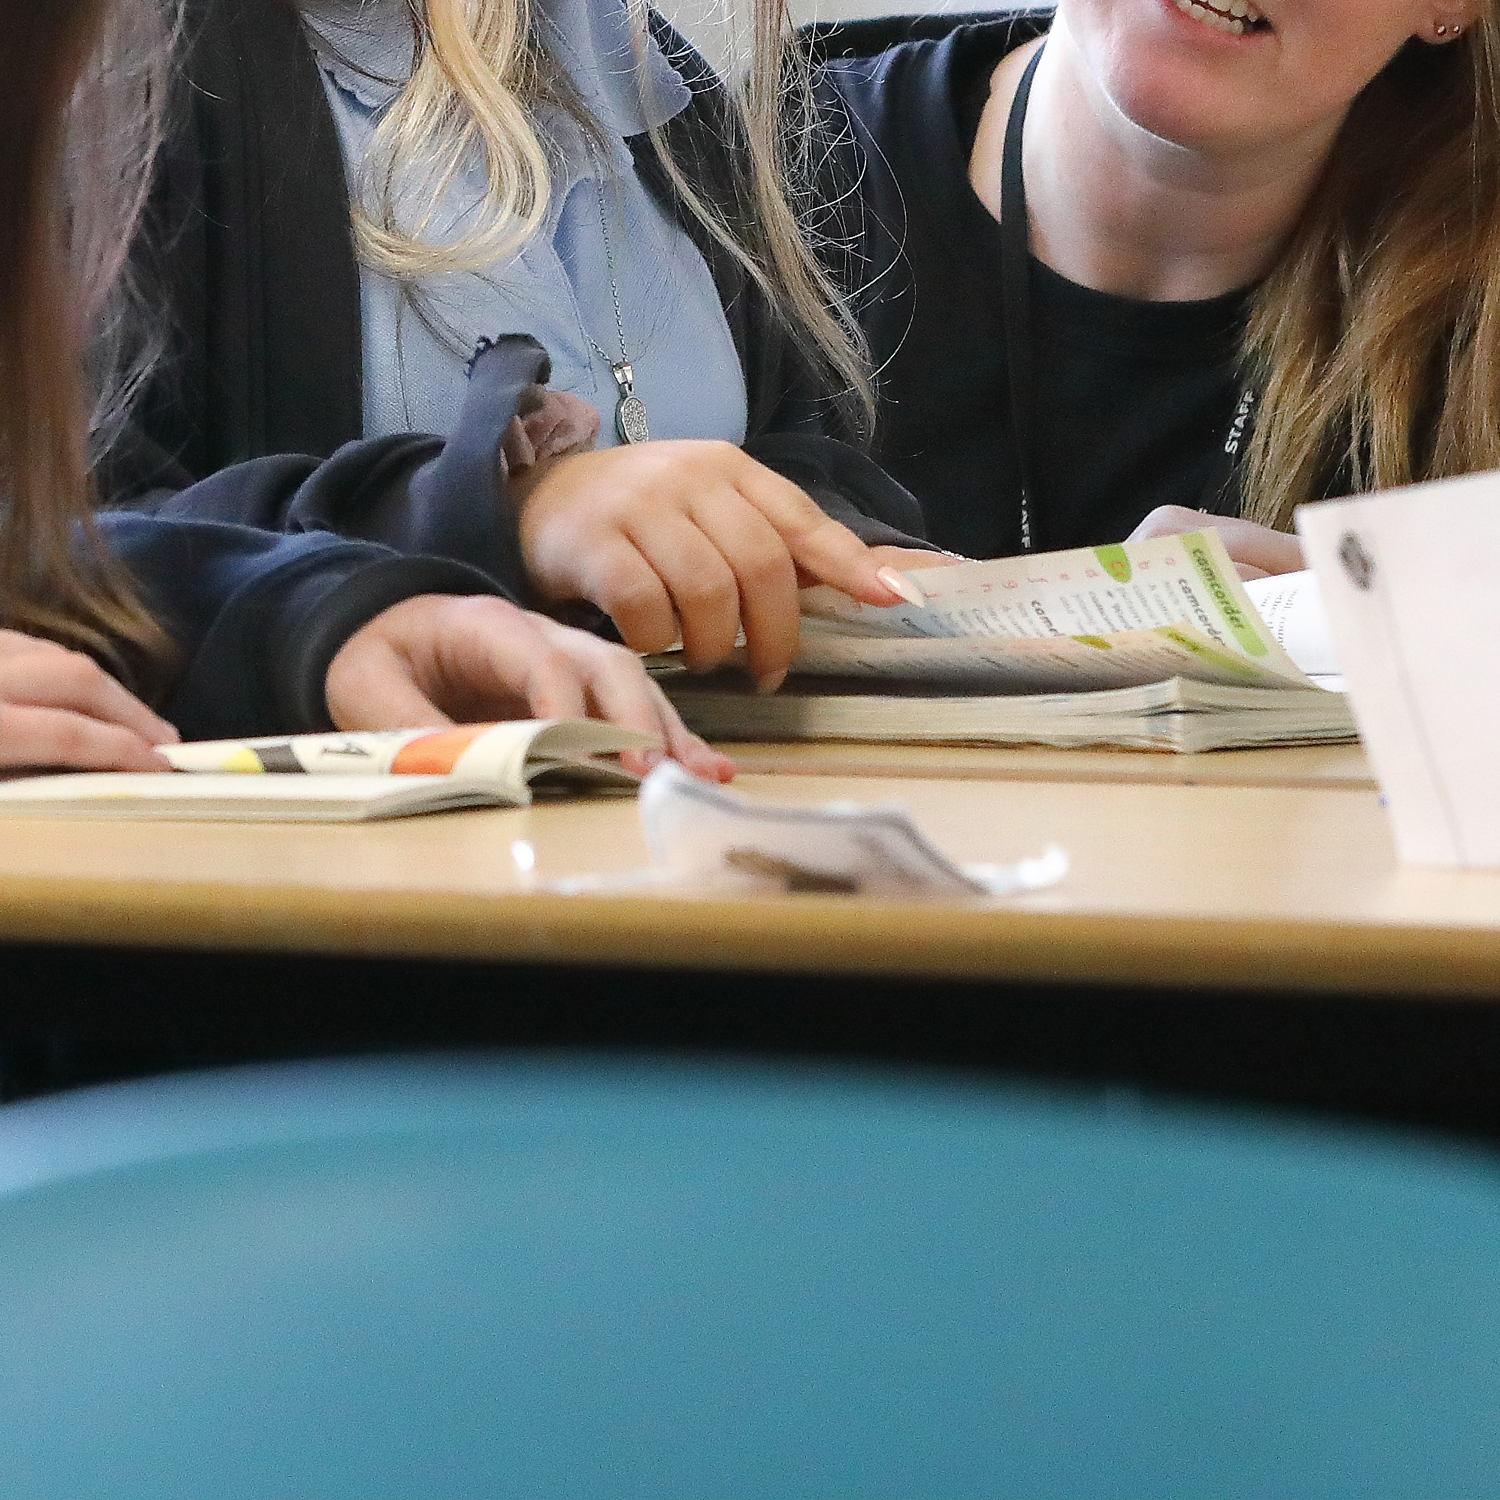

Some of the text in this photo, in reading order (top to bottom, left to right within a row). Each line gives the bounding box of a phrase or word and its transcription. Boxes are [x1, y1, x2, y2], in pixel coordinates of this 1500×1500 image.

[1224, 390, 1255, 454] STAFF
[1021, 489, 1032, 549] AFF
[1192, 548, 1244, 629] camcorder
